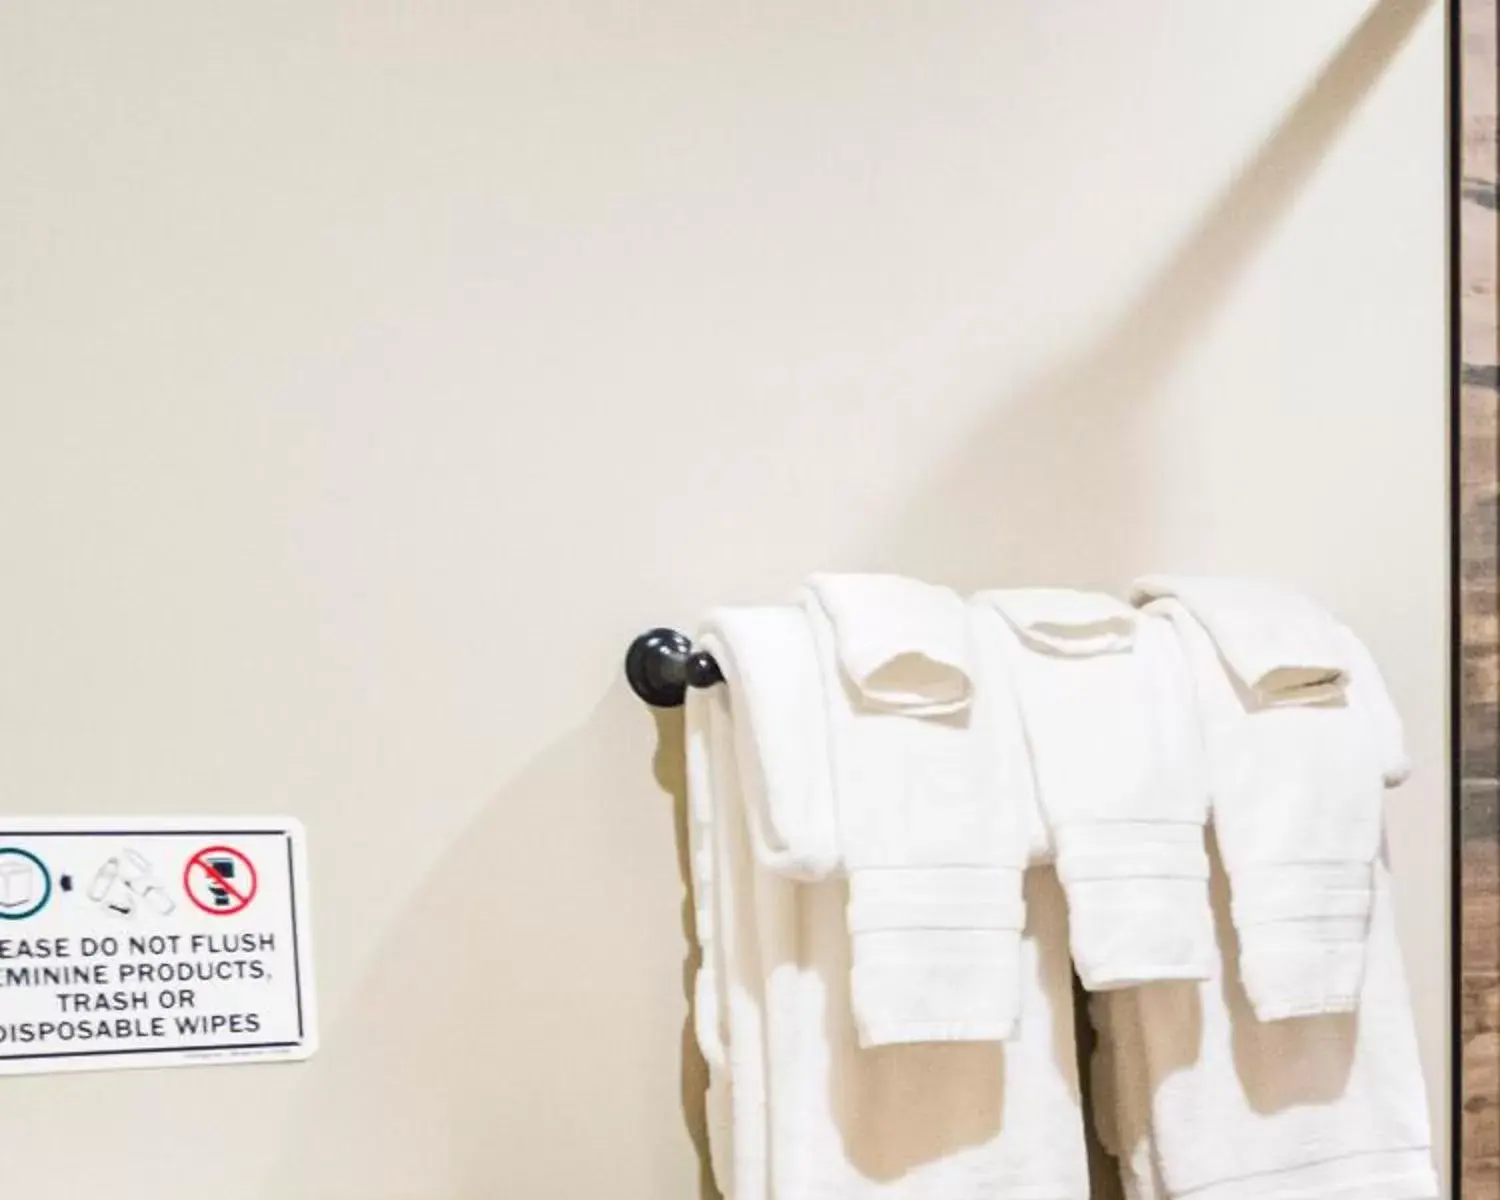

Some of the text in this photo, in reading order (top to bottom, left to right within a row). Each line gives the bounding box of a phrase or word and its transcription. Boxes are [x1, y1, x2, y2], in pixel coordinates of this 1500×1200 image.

[0, 932, 276, 958] EASE DO NOT FLUSH
[0, 959, 273, 986] MININE PRODUCTS,
[57, 989, 196, 1013] TRASH OR
[174, 1013, 261, 1036] WIPES
